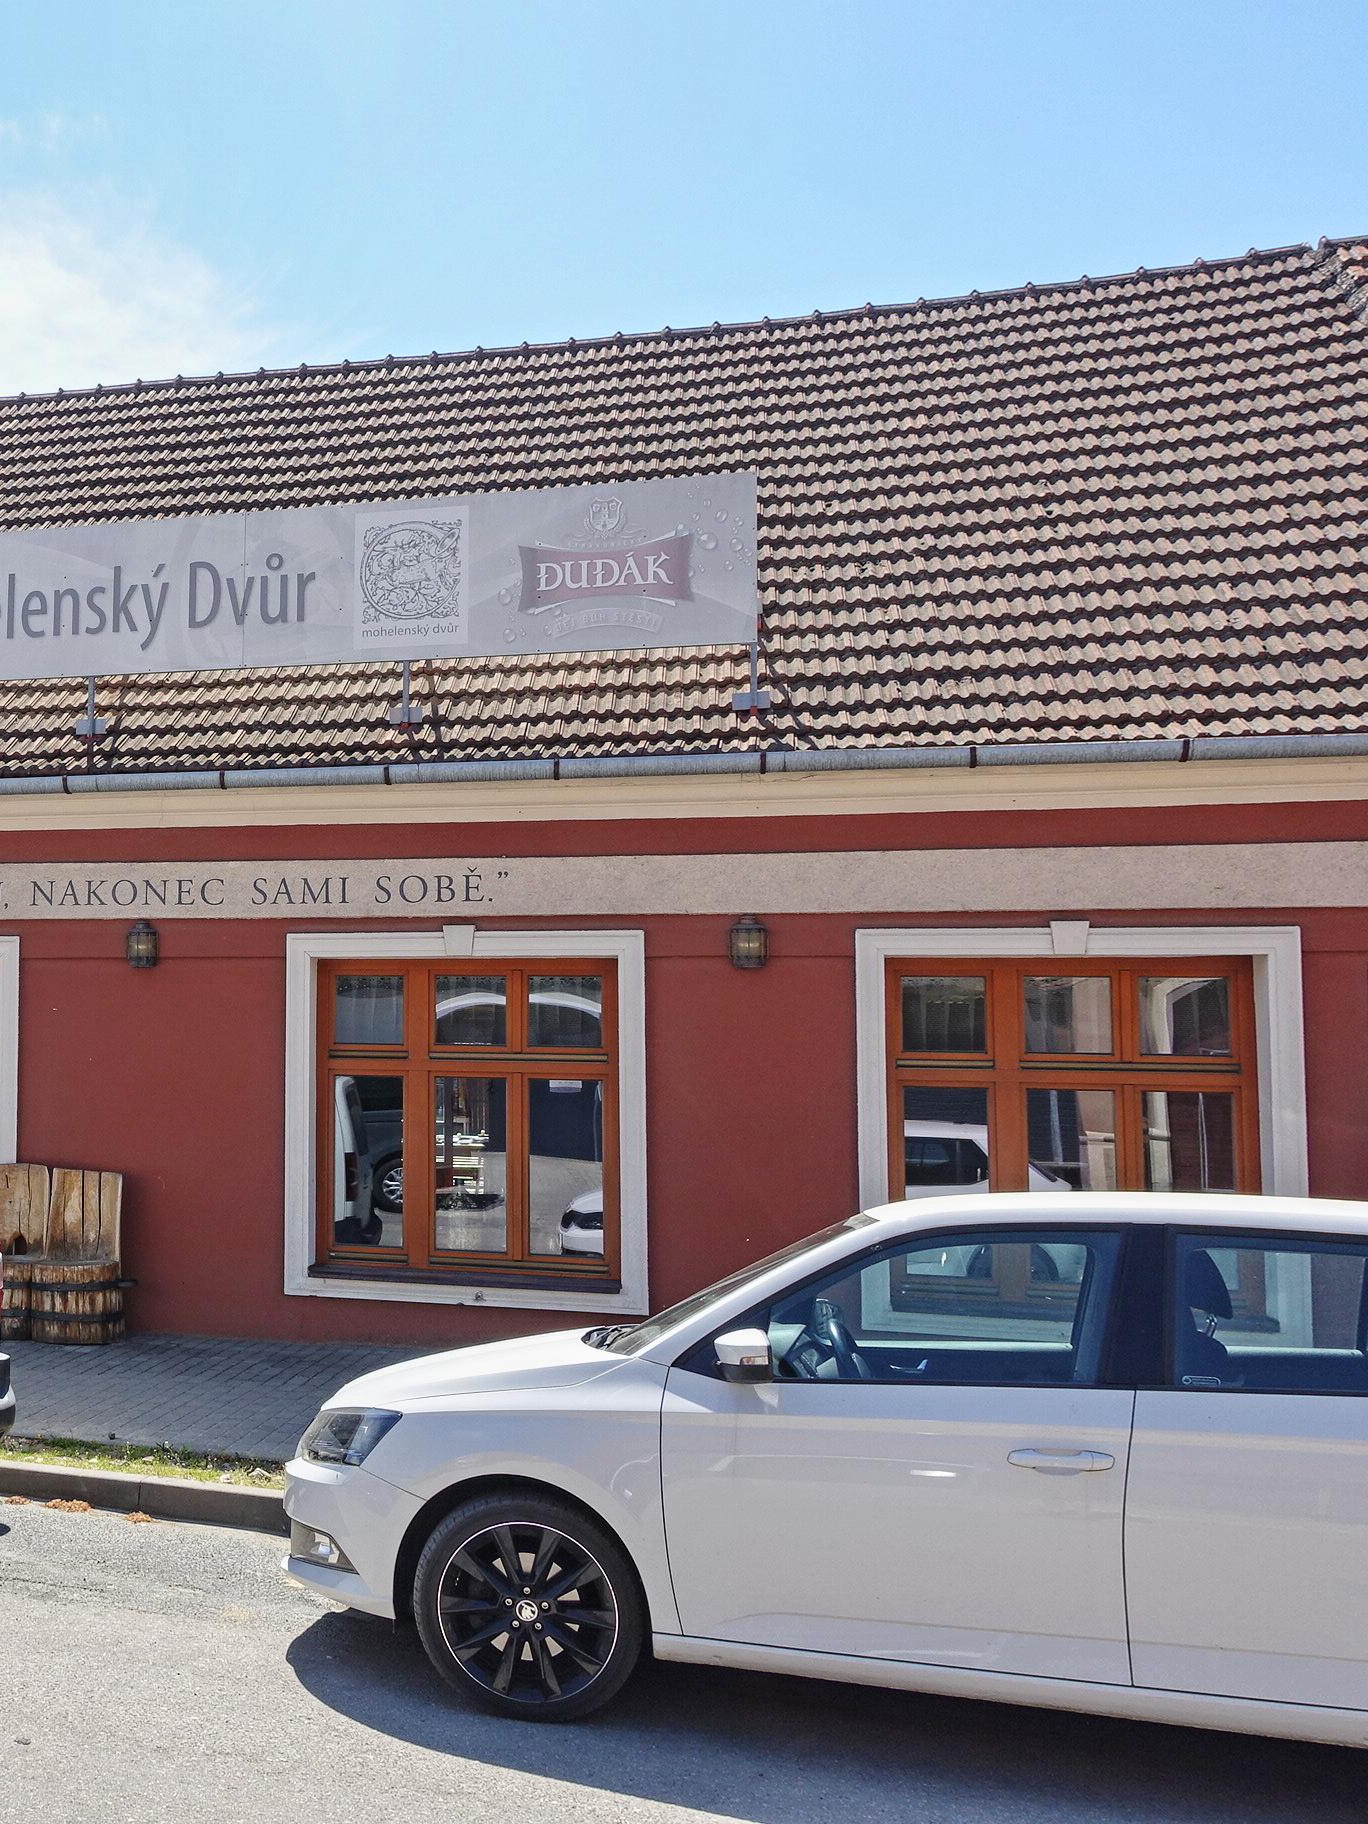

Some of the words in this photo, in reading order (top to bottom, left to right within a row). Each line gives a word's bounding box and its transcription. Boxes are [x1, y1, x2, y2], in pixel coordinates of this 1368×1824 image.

[187, 553, 317, 629] Dvůr
[362, 623, 430, 638] mohelenský
[432, 622, 459, 634] dvůr
[30, 878, 226, 908] NAKONEC
[251, 875, 351, 905] SAMI
